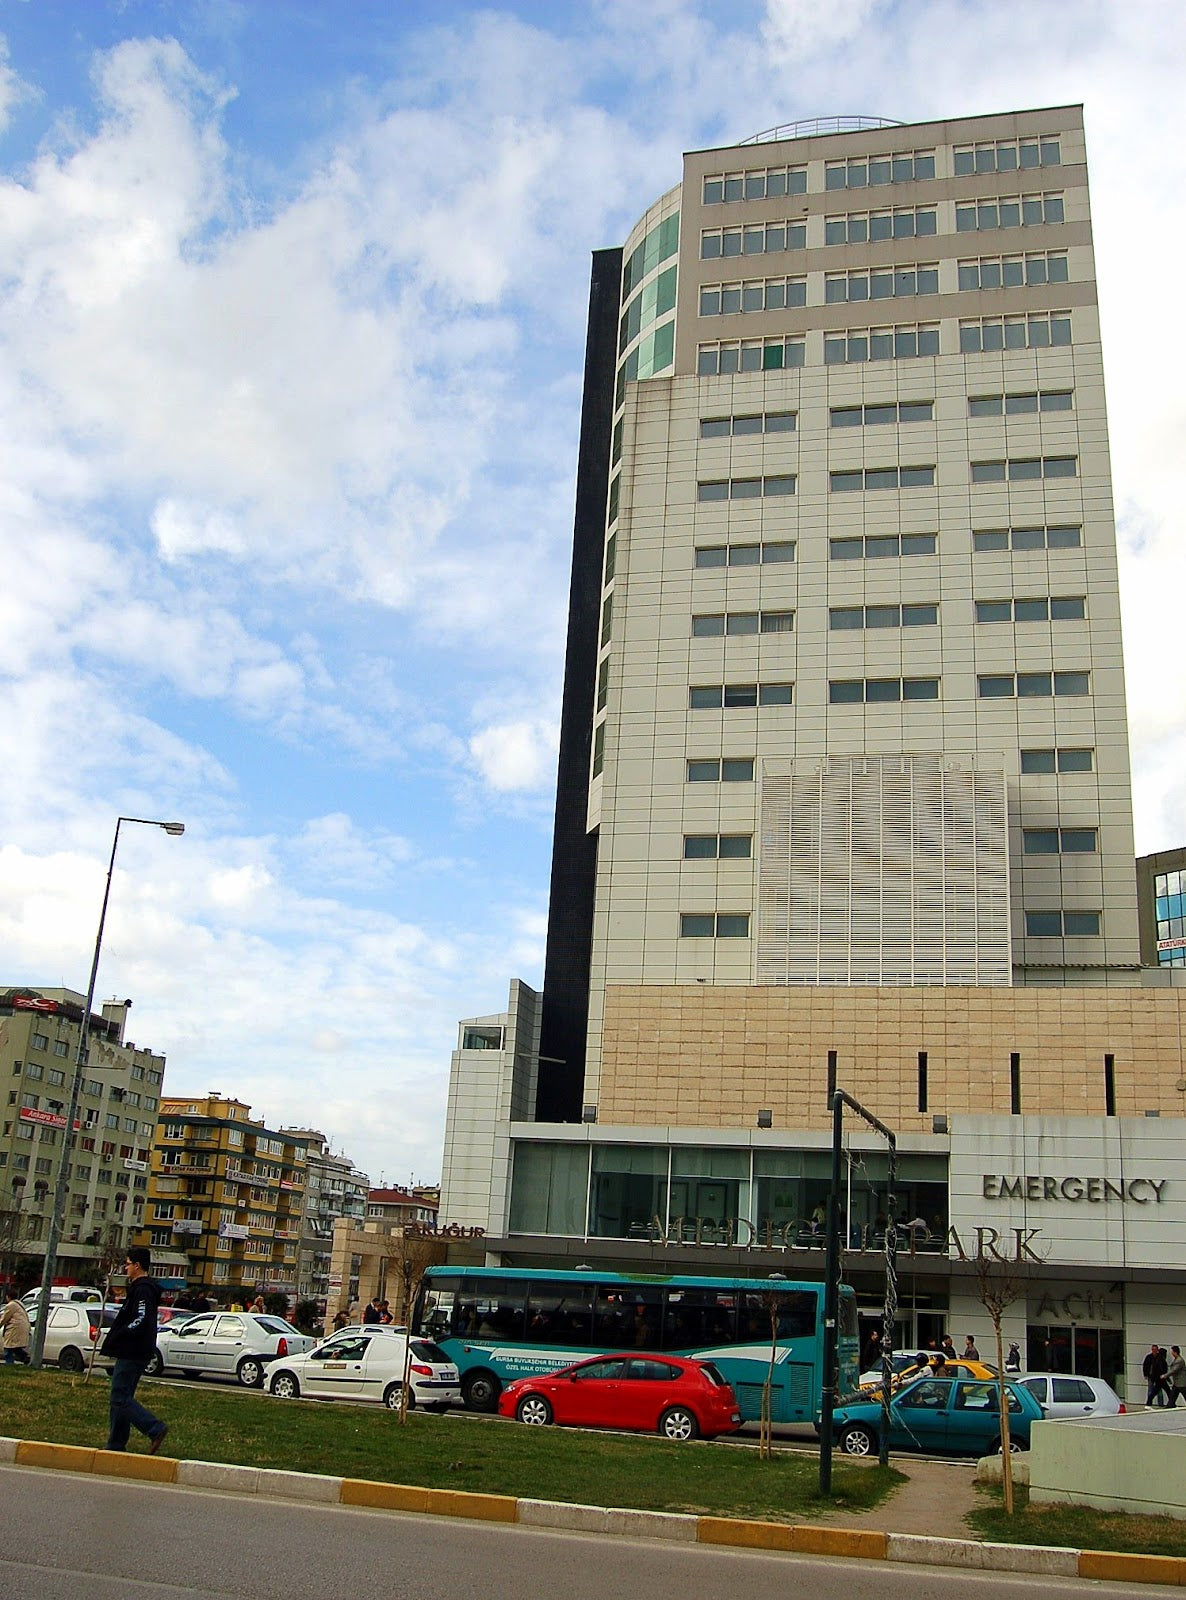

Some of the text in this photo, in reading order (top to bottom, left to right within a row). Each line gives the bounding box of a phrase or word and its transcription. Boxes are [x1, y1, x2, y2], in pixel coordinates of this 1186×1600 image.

[28, 1110, 51, 1121] Ankara
[983, 1174, 1167, 1204] EMERGENCY
[906, 1223, 1047, 1266] PARK
